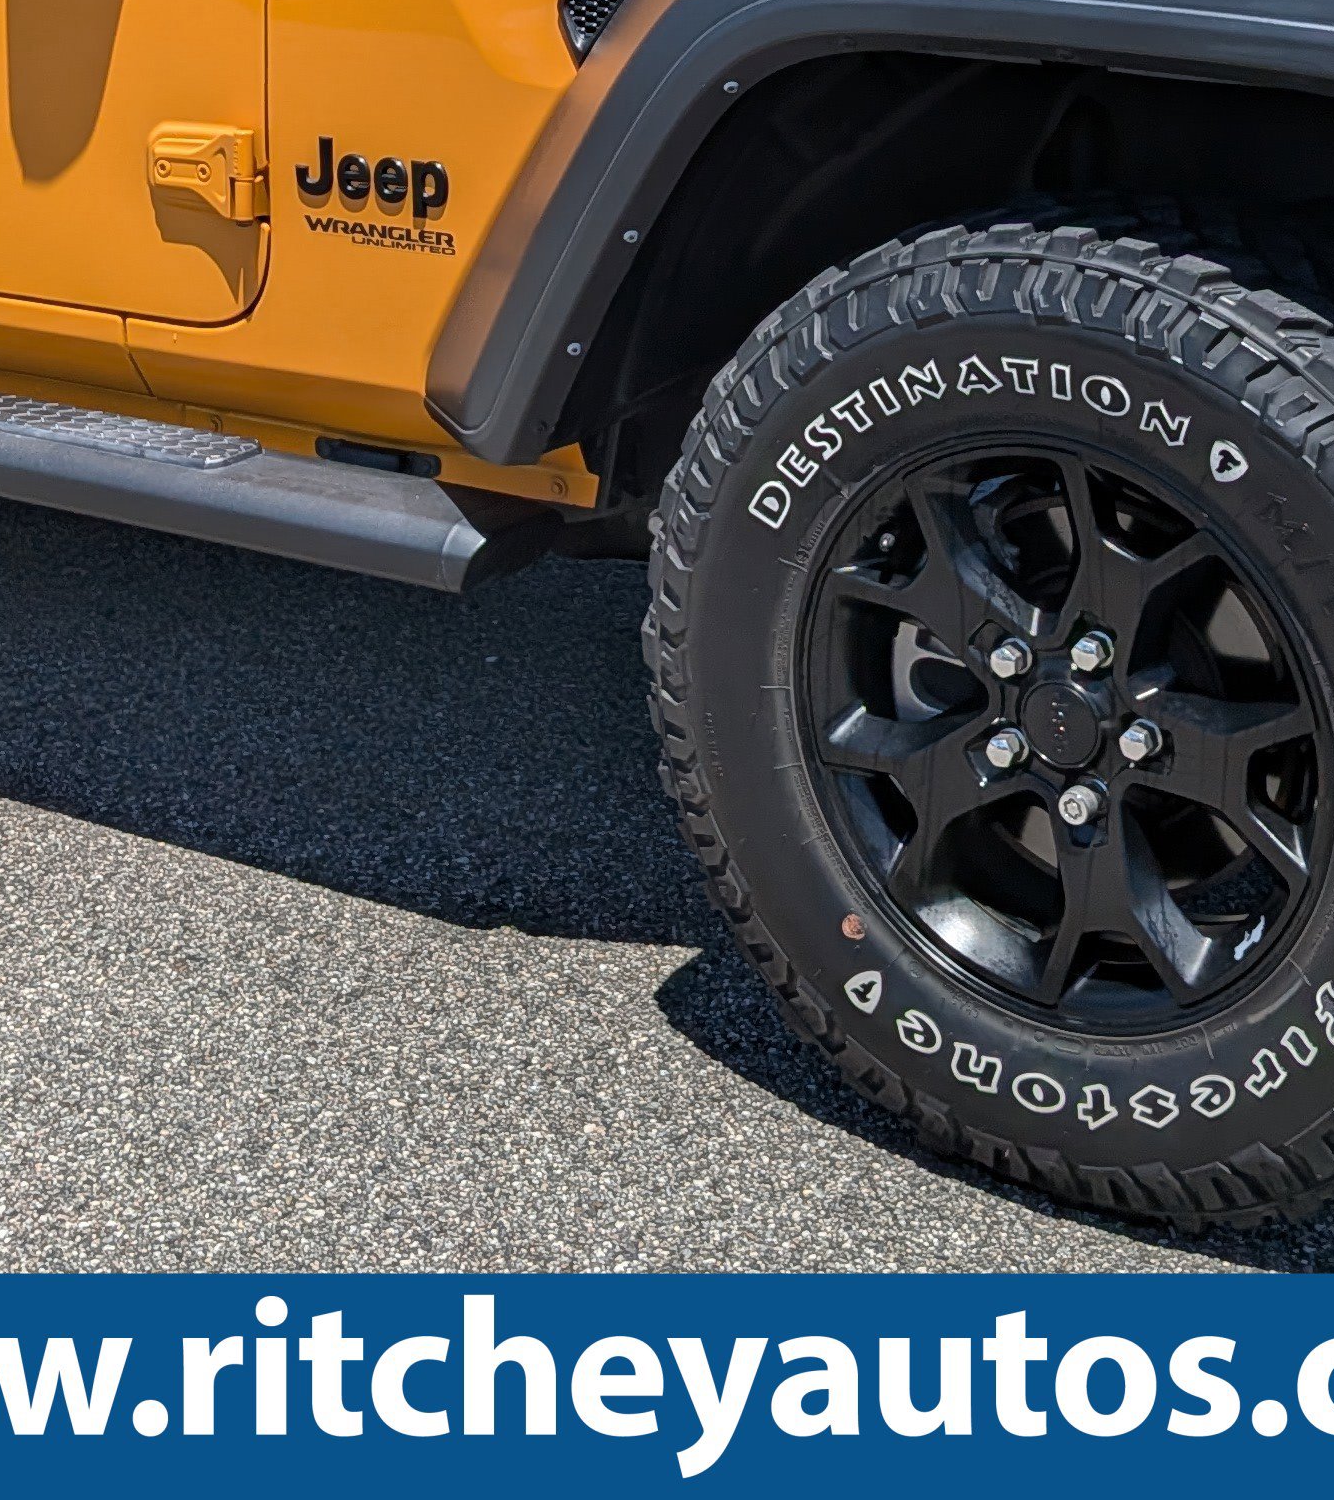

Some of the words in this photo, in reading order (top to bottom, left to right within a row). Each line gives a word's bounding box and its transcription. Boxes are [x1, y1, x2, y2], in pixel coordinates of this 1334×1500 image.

[295, 136, 449, 219] Jeep
[304, 214, 455, 248] WRANGLER
[351, 235, 456, 256] UNLIMITED
[747, 354, 1192, 530] DESTINATION
